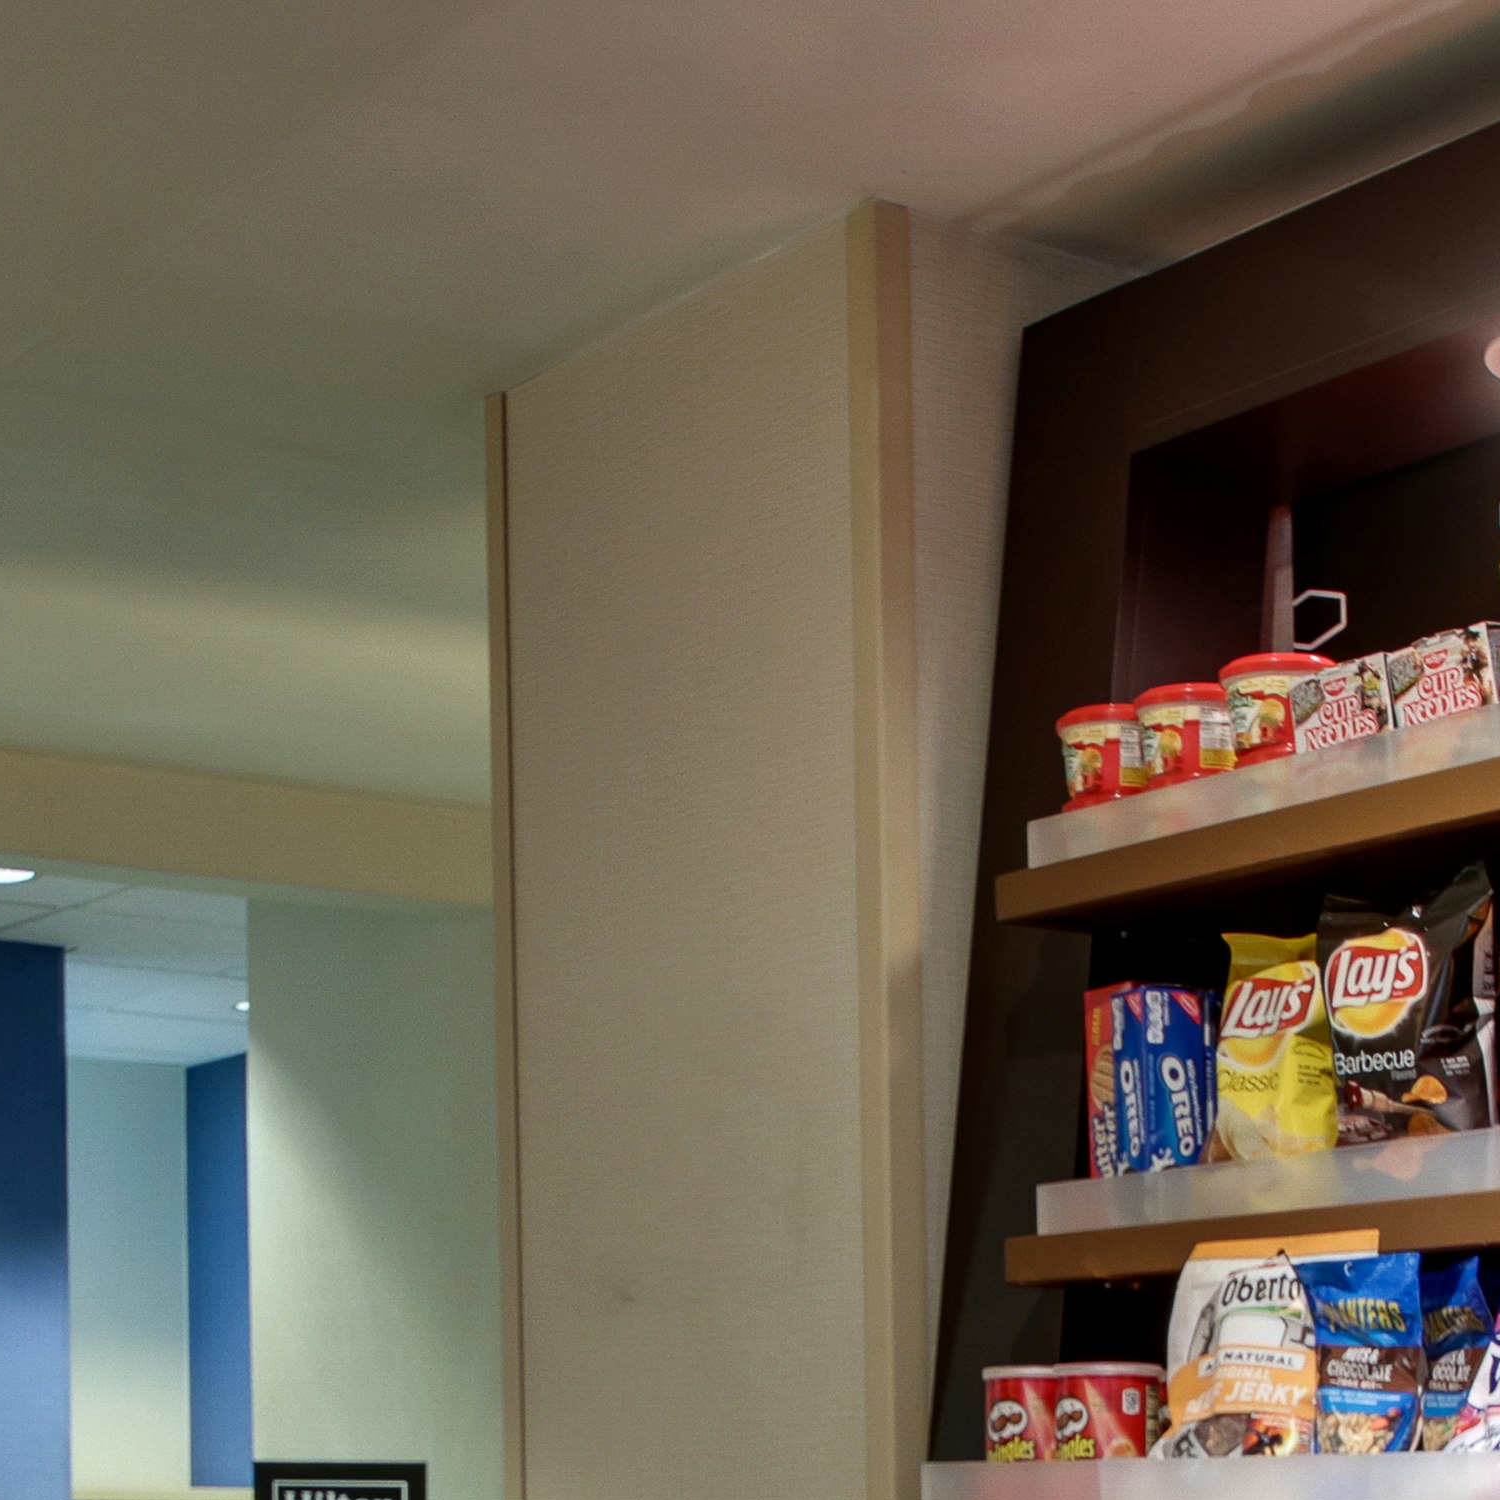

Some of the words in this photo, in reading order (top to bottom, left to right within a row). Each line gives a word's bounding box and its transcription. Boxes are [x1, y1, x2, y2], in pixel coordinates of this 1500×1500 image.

[1418, 667, 1463, 700] CUP
[1318, 694, 1363, 725] CUP
[1402, 682, 1483, 727] NOODLES
[1304, 708, 1380, 751] NOODLES
[1331, 946, 1419, 1009] Lay's
[1220, 979, 1312, 1039] Lay's
[1334, 1048, 1416, 1076] Barbecue
[1217, 1068, 1280, 1093] Classic
[1120, 1060, 1141, 1158] OREO
[1161, 1056, 1195, 1157] OREO
[1223, 1350, 1296, 1367] NATURAL
[1326, 1358, 1393, 1382] CHOCOLATE
[1224, 1380, 1309, 1406] JERKY
